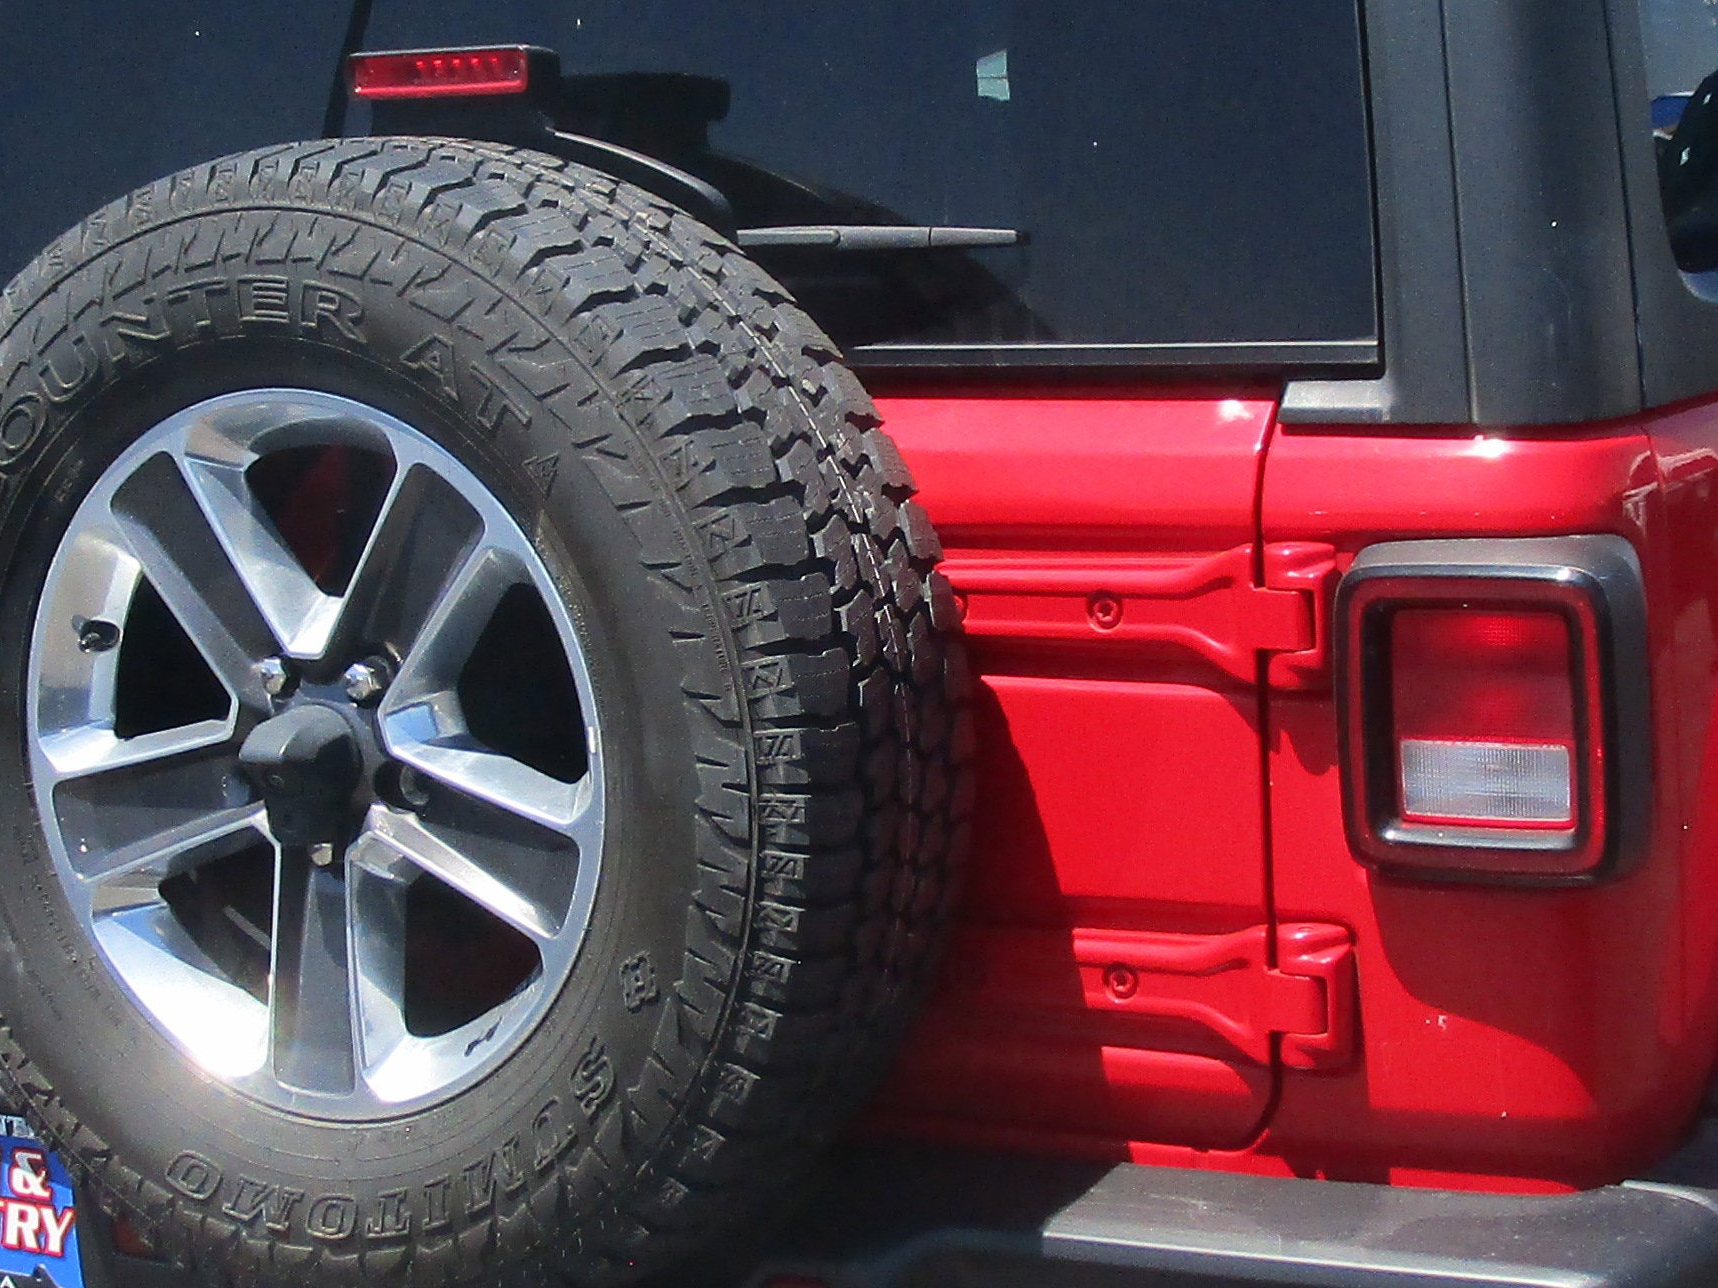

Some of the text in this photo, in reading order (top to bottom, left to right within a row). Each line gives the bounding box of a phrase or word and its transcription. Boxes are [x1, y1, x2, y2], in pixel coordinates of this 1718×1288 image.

[398, 314, 534, 431] AT
[9, 1145, 53, 1201] &
[163, 1034, 616, 1242] SUMITOMO
